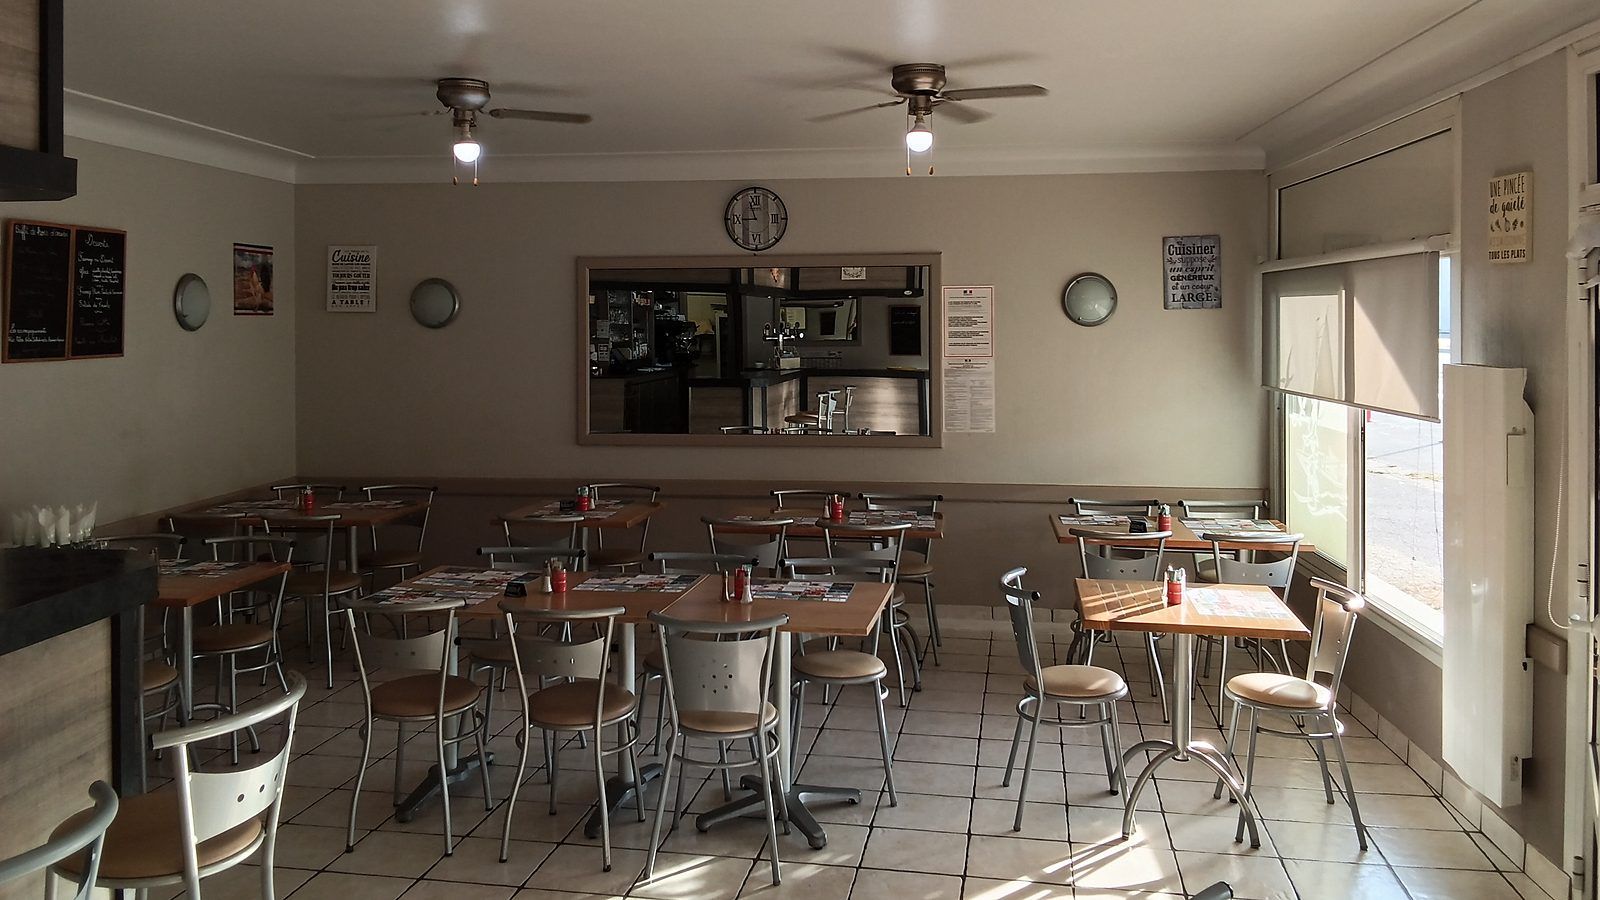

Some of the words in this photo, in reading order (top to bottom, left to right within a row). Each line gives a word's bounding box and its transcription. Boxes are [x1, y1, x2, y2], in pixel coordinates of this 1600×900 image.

[1490, 180, 1501, 198] UNE
[1504, 174, 1525, 195] PINCÉE
[1490, 199, 1499, 214] de
[332, 249, 371, 263] Cuisine
[1168, 243, 1216, 256] Cuisiner
[1489, 251, 1500, 260] TOUS
[1501, 250, 1510, 259] LES
[1511, 249, 1526, 259] PLATS
[1184, 264, 1215, 274] esprit
[1171, 292, 1217, 303] LARGE.
